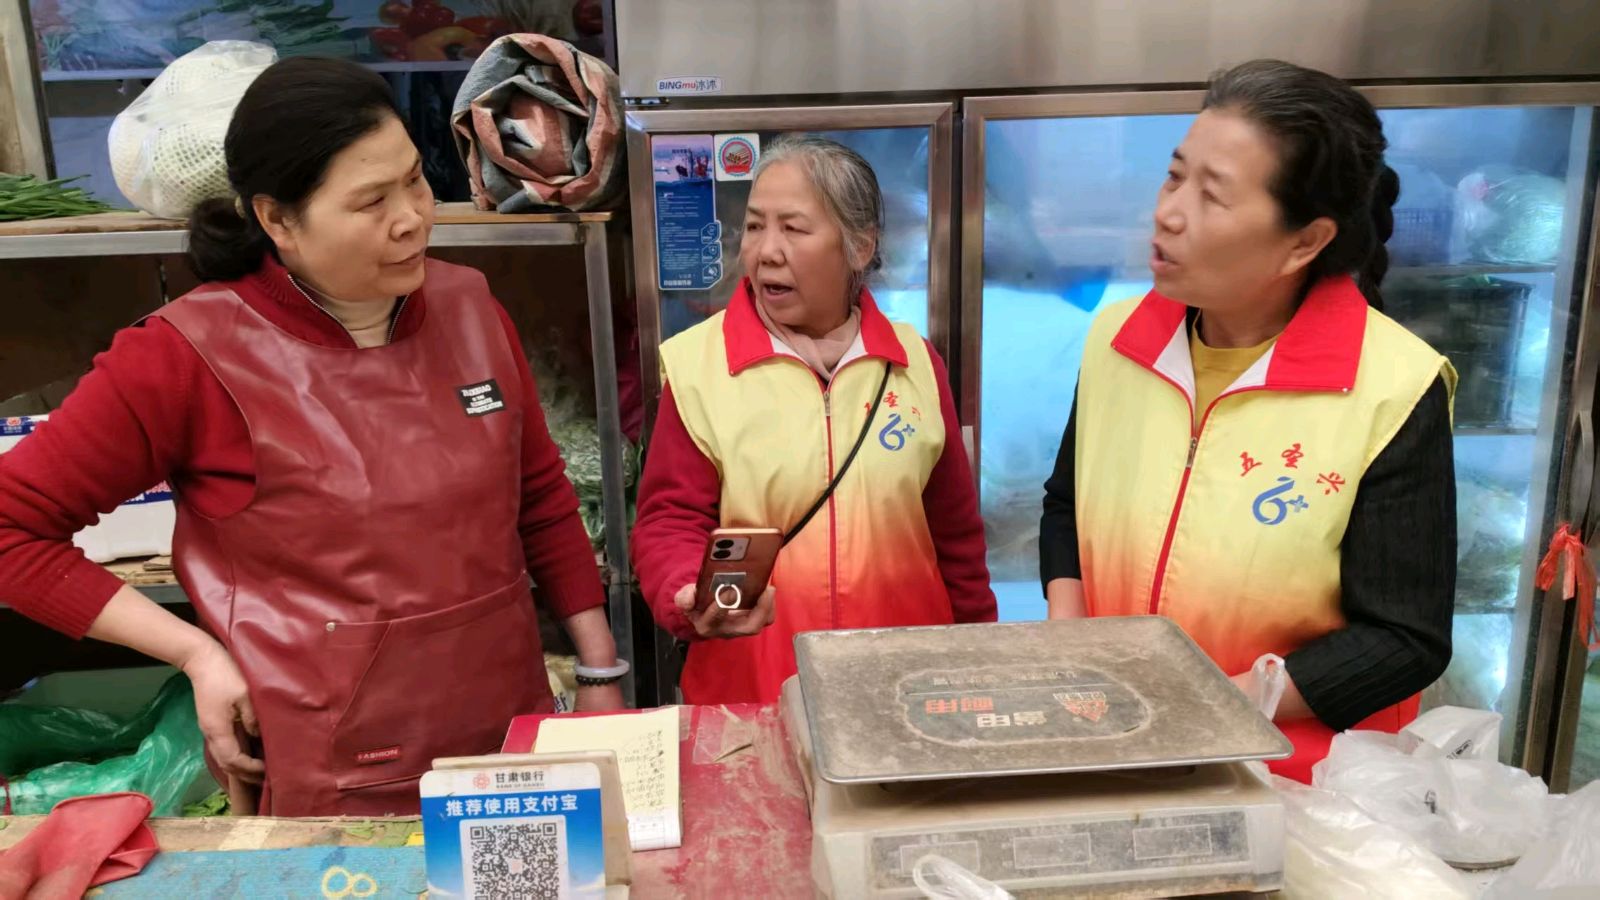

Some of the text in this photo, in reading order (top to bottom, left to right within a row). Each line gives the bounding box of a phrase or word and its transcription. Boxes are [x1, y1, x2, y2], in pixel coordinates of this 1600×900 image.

[495, 771, 544, 783] 甘肃银行
[446, 794, 578, 817] 推荐使用支付宝
